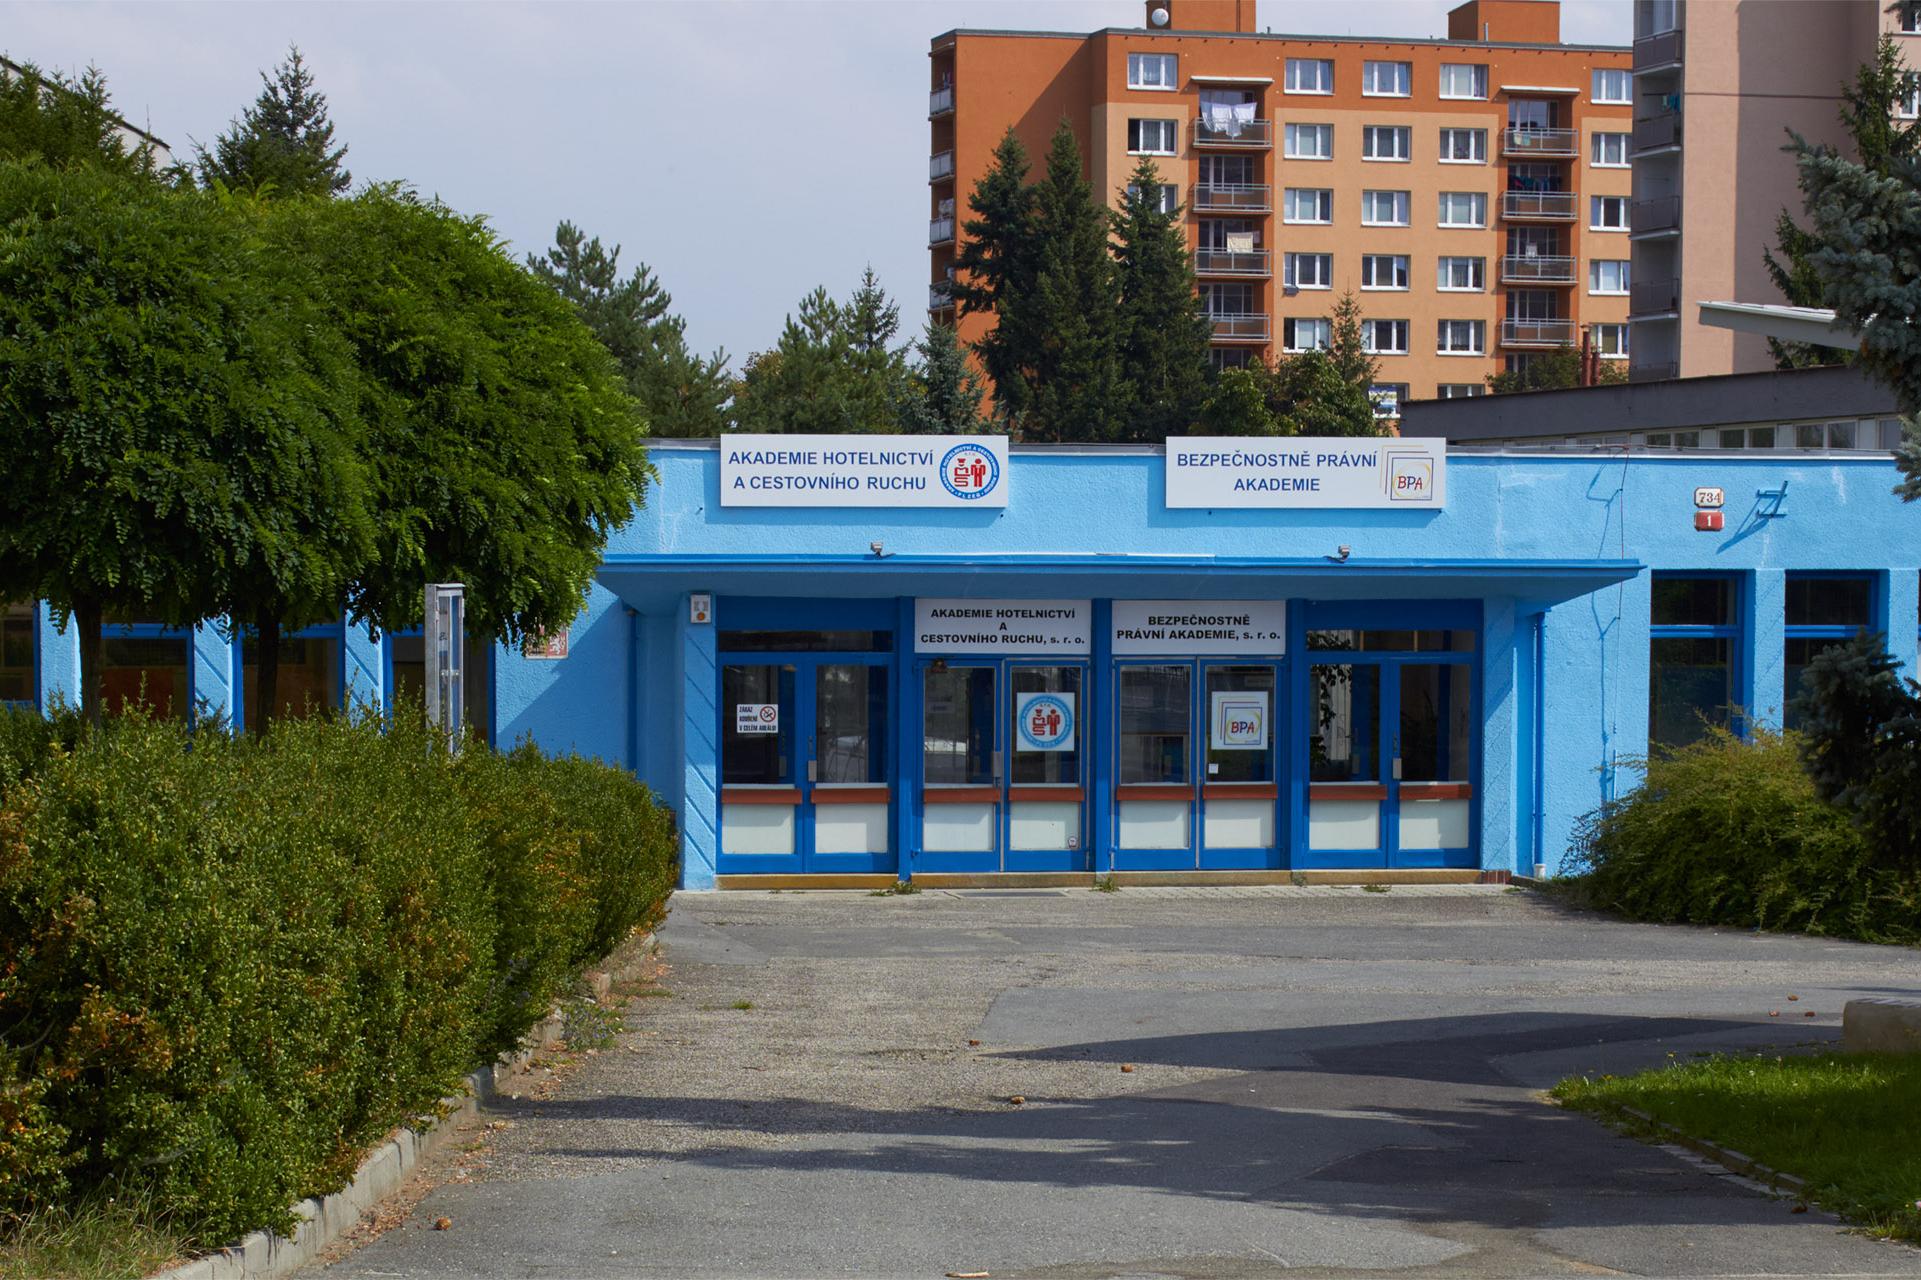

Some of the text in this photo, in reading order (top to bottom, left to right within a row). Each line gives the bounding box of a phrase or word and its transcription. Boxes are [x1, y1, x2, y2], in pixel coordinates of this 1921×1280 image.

[728, 449, 934, 465] AKADEMIE HOTELNICTVÍ
[1177, 450, 1378, 467] BEZPEČNOSTNĚ PRÁVNÍ
[733, 476, 745, 489] A
[750, 473, 860, 490] CESTOVNÍHO
[867, 476, 926, 490] RUCHU
[1234, 478, 1321, 491] AKADEMIE
[1397, 475, 1423, 490] BPA
[1699, 492, 1720, 503] 734
[1707, 514, 1712, 527] 1
[930, 607, 1075, 619] AKADEMIE HOTELNICTVÍ
[999, 622, 1007, 631] A
[1148, 614, 1250, 626] BEZPEČNOSTNĚ
[920, 633, 998, 644] CESTOVNÍHO
[1001, 634, 1047, 645] RUCHU,
[1116, 627, 1165, 639] PRÁVNÍ
[1168, 630, 1239, 641] AKADEMIE,
[1231, 721, 1255, 734] BPA
